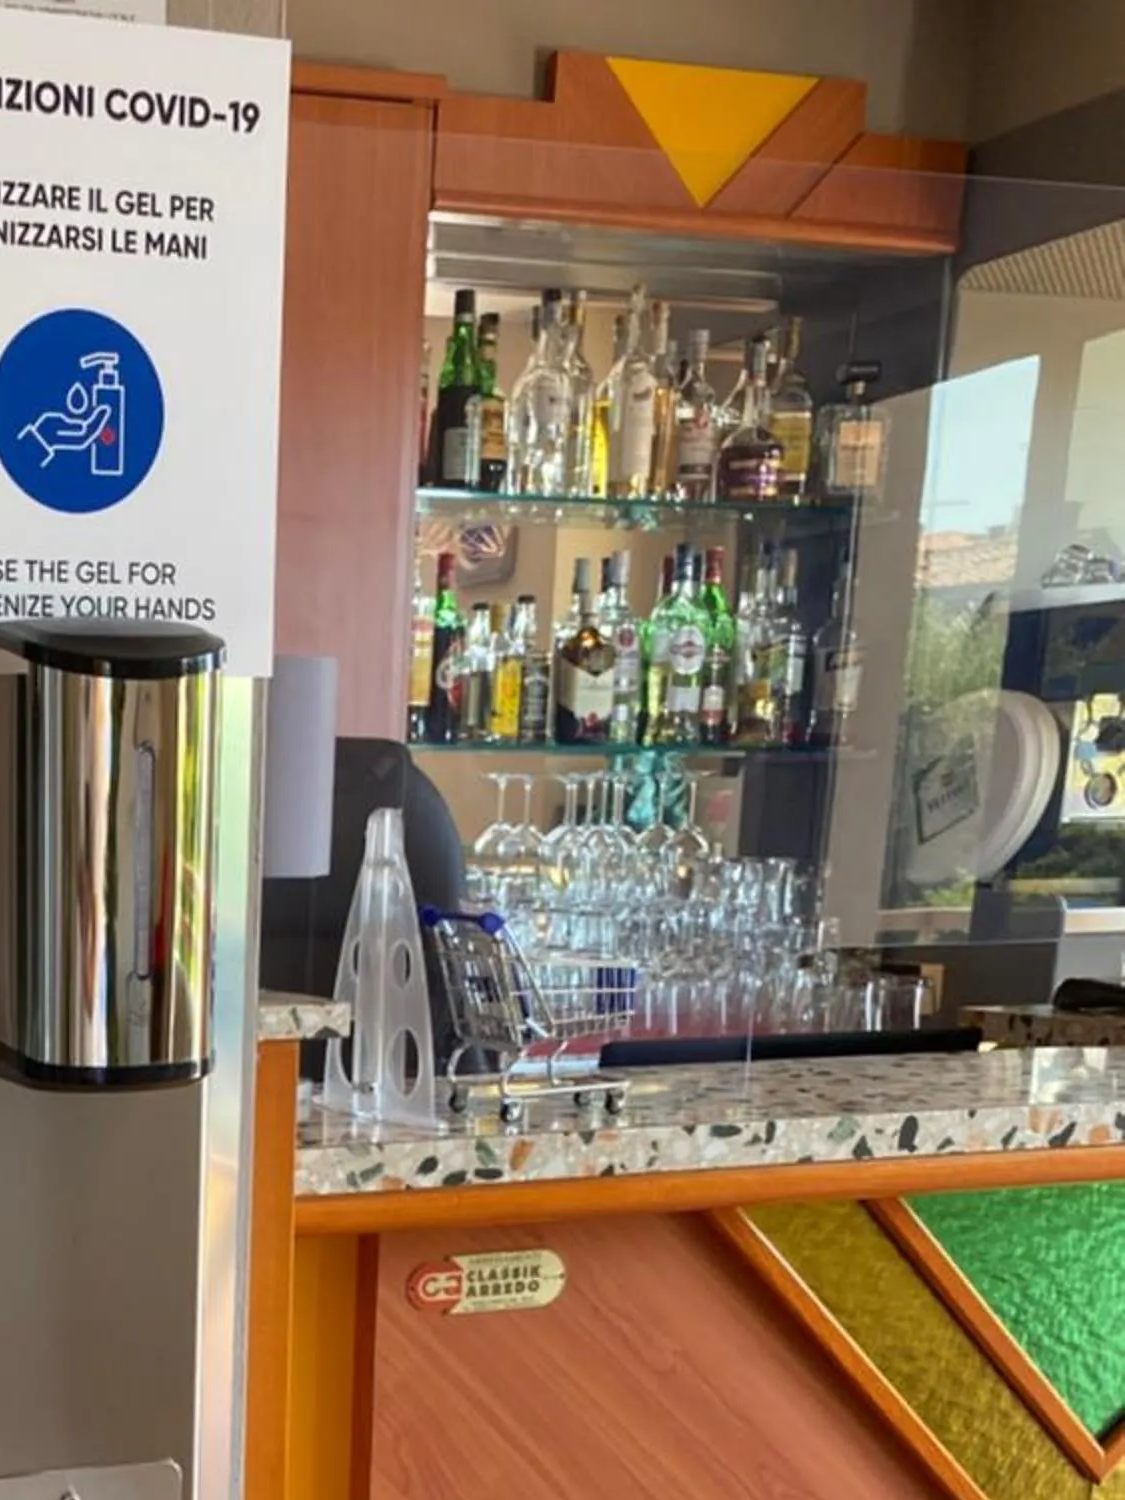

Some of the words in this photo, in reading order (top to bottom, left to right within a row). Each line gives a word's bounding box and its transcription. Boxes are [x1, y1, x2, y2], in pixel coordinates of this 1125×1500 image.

[104, 88, 261, 134] COVID-19
[87, 187, 108, 213] IL
[114, 190, 163, 218] GEL
[168, 194, 216, 222] PER
[110, 228, 139, 255] LE
[143, 231, 208, 260] MANI
[24, 559, 70, 583] THE
[75, 560, 122, 585] GEL
[127, 561, 177, 586] FOR
[60, 595, 130, 620] YOUR
[133, 597, 217, 622] HANDS
[466, 1279, 540, 1298] ARREDO
